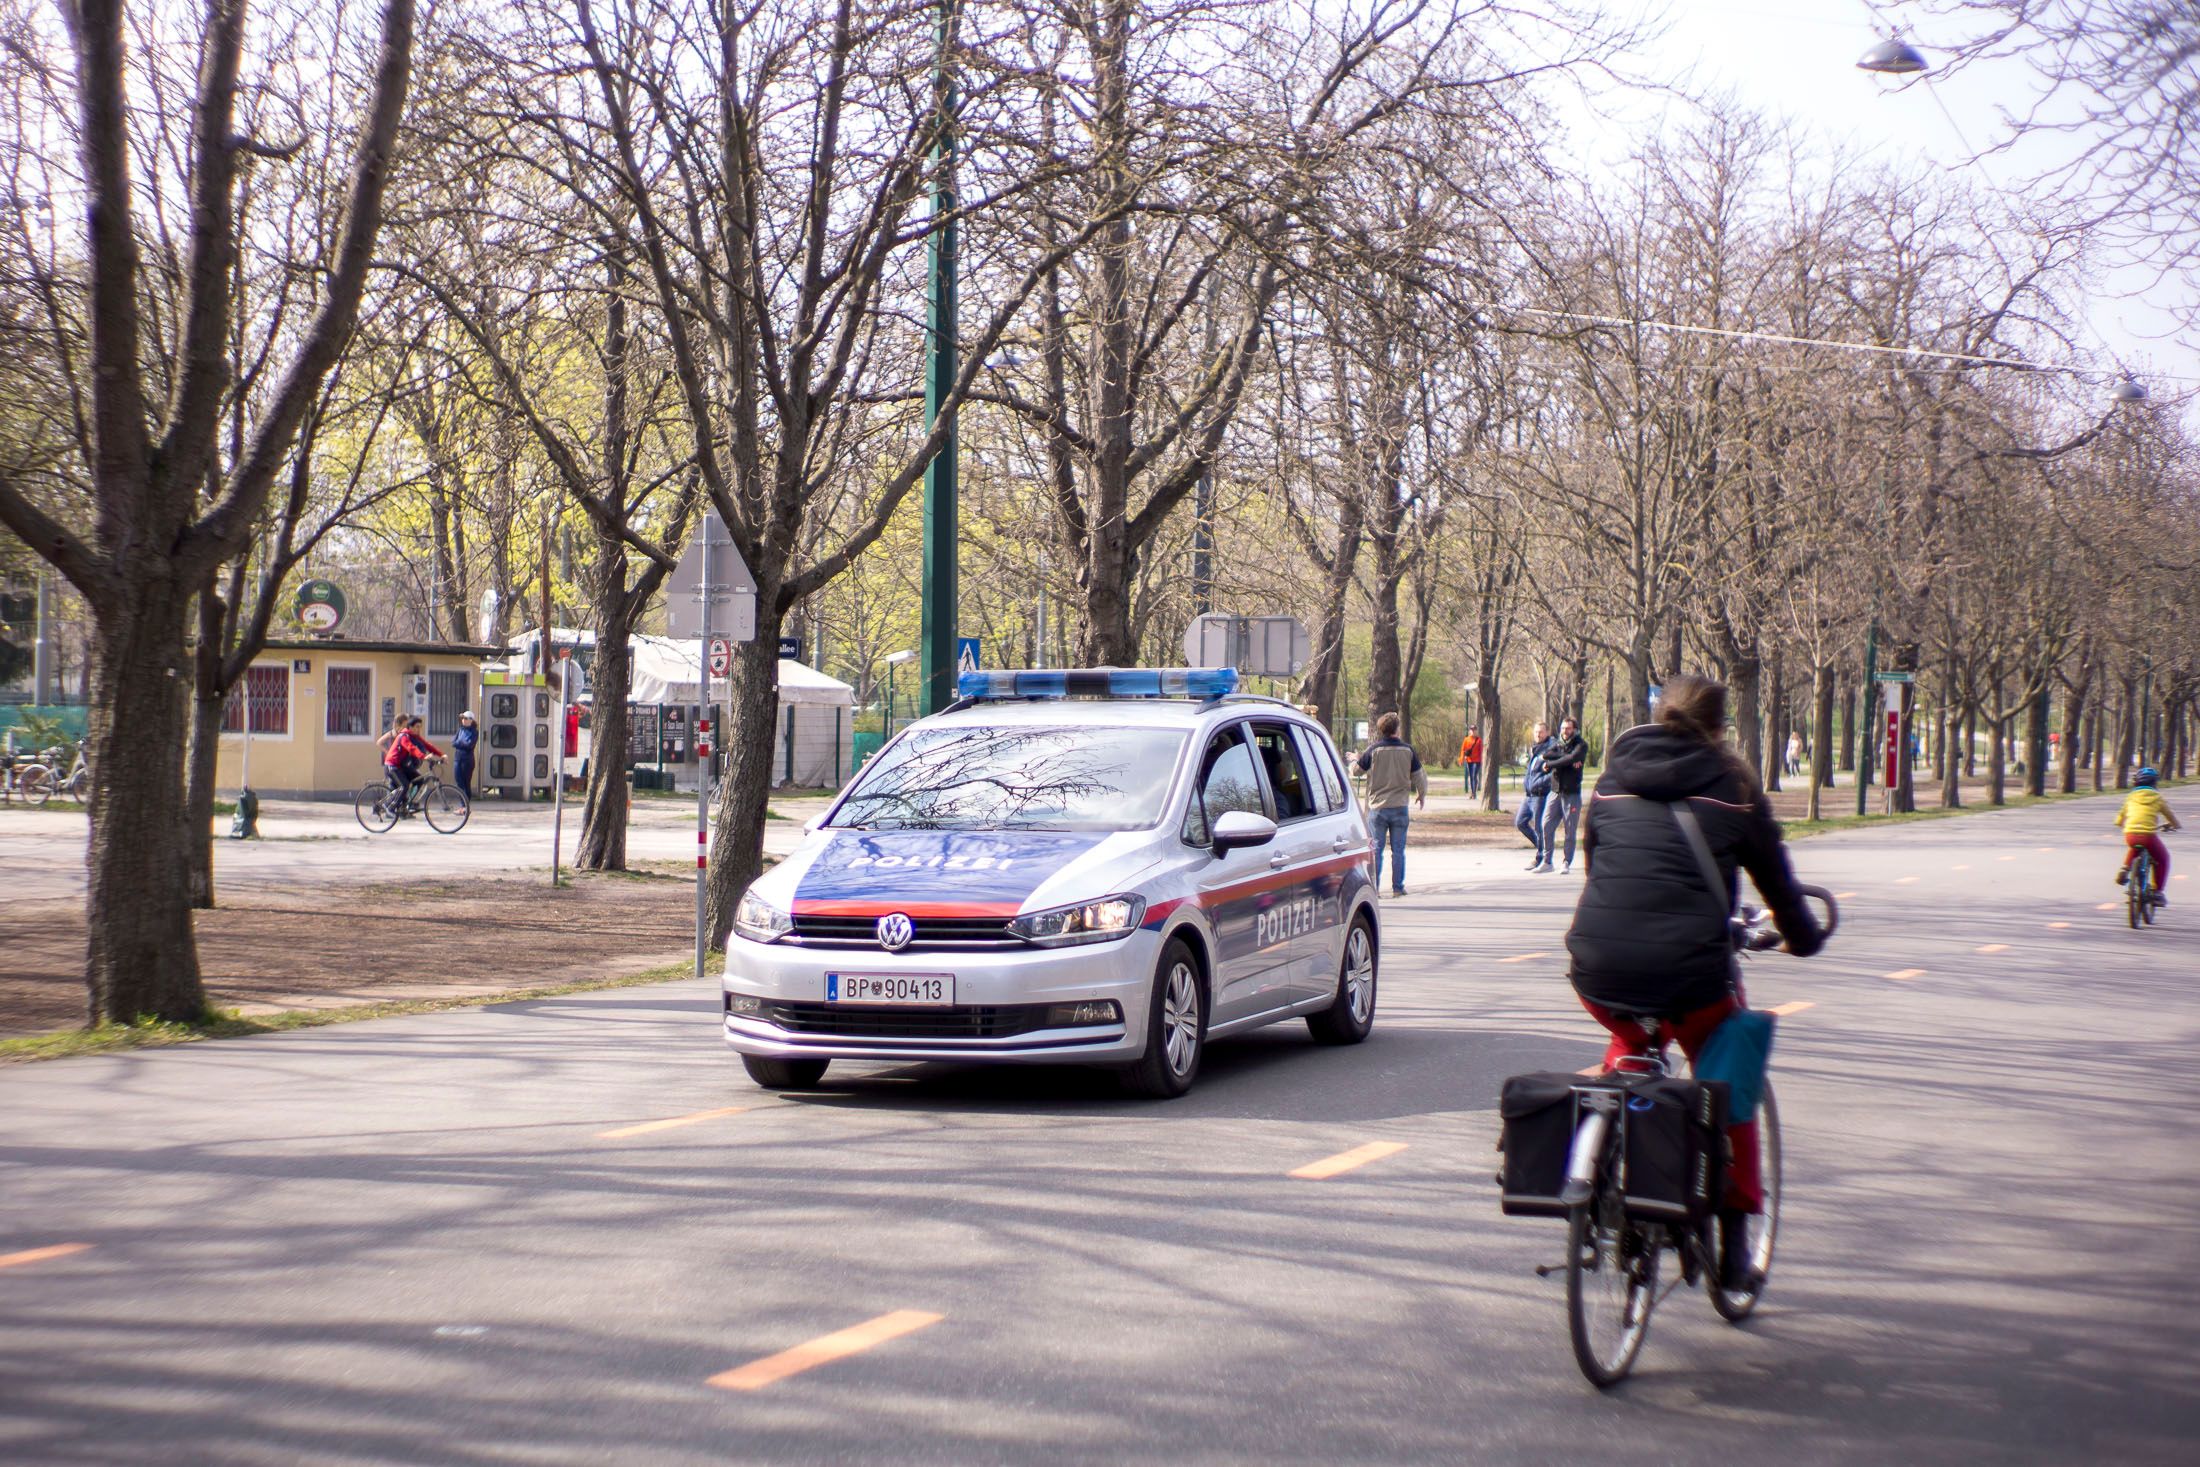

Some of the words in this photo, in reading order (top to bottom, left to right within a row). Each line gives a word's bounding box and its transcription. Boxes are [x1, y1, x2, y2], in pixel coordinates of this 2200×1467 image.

[848, 856, 1014, 871] POLIZEI
[1257, 898, 1316, 947] POLIZEI
[846, 978, 869, 998] BP
[885, 979, 942, 1000] 90413
